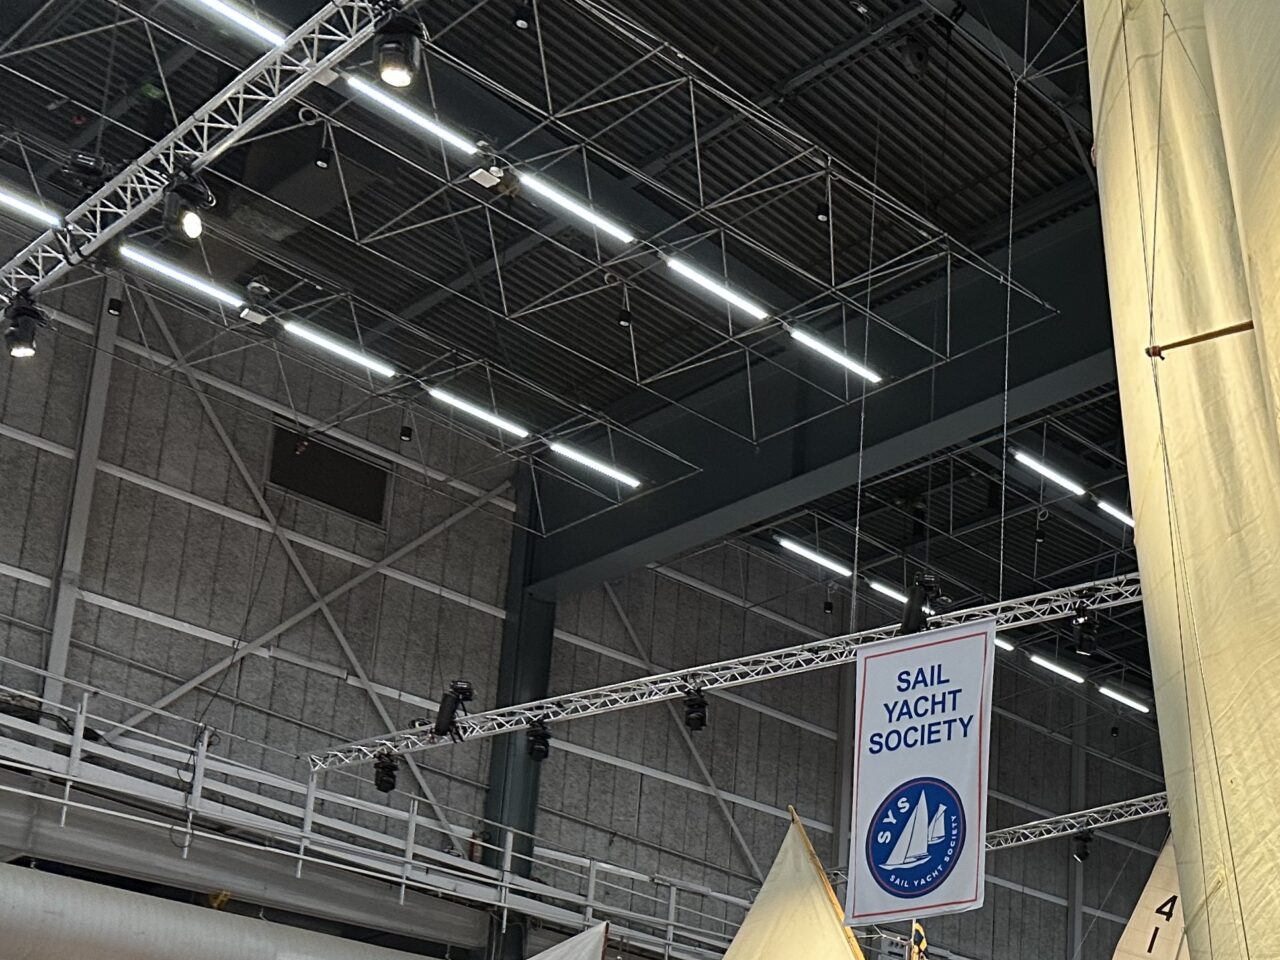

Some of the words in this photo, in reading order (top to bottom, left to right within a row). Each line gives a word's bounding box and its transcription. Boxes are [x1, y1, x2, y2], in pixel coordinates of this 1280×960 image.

[896, 663, 950, 692] SAIL
[883, 688, 962, 723] YACHT
[868, 714, 974, 754] SOCIETY
[877, 797, 910, 844] SYS
[889, 874, 909, 887] SAIL
[913, 864, 943, 886] YACHT
[943, 815, 958, 862] SOCIETY
[1154, 894, 1178, 922] 4
